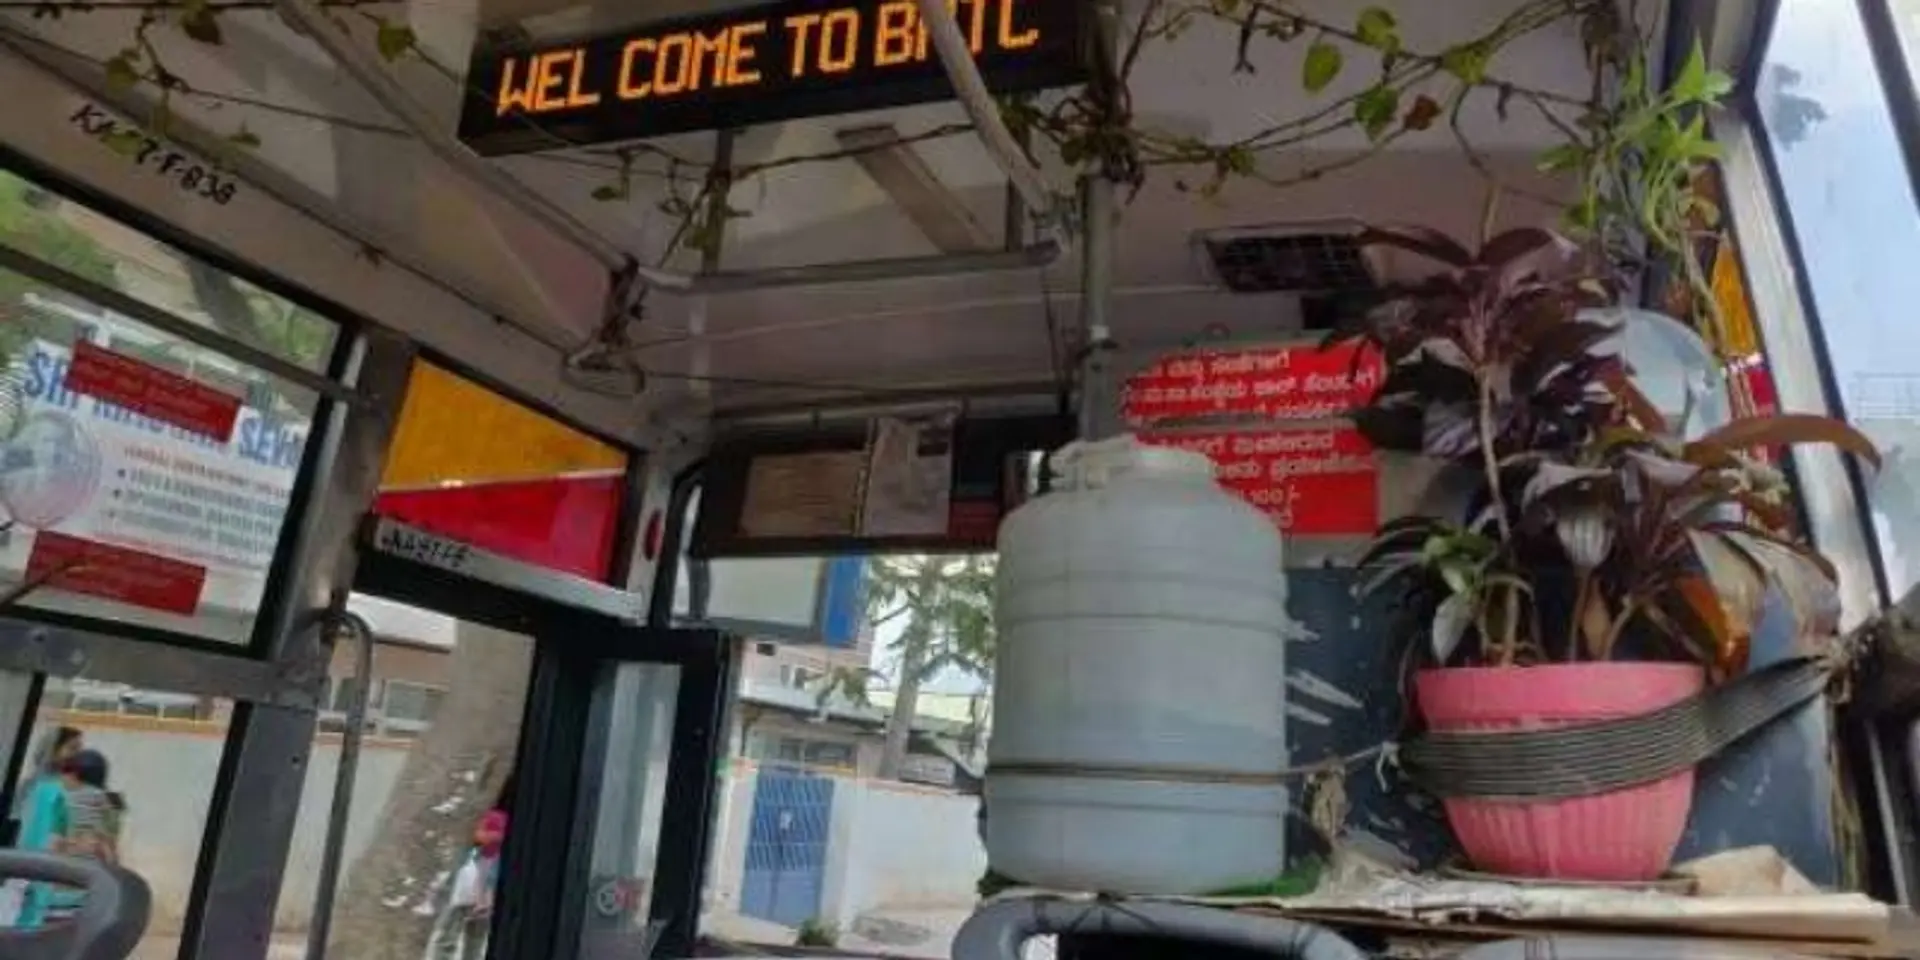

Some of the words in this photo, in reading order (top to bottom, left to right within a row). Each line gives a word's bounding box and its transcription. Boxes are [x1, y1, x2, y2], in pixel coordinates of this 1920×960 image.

[496, 48, 600, 115] WEL
[617, 22, 767, 99] COME
[783, 8, 858, 76] TO
